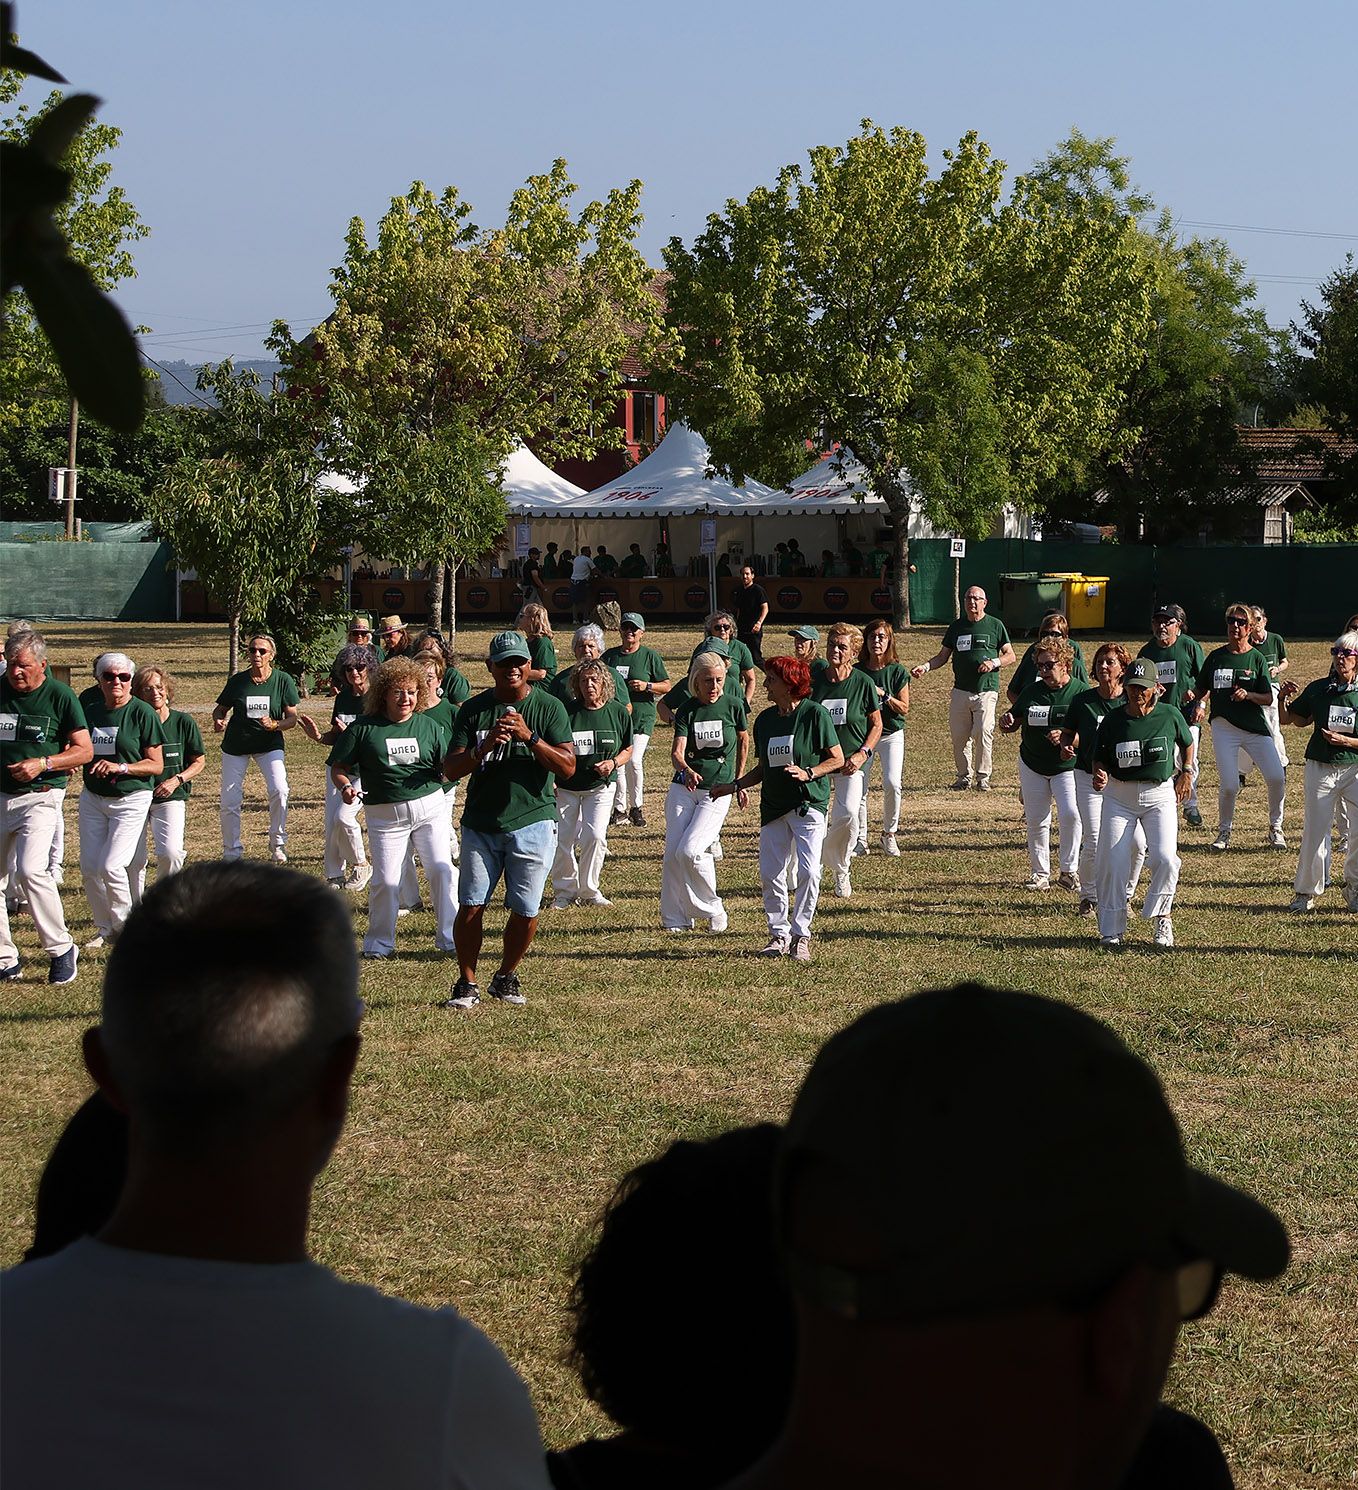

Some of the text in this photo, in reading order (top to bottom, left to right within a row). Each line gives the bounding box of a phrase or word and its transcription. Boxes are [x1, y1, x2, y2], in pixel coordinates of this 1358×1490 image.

[602, 490, 659, 501] 1906
[790, 489, 848, 500] 1906
[248, 703, 267, 711] UNED
[830, 707, 843, 715] NED
[1331, 715, 1352, 725] UNED
[0, 722, 14, 731] NED
[697, 731, 720, 740] UNED
[93, 736, 113, 745] UNED
[573, 737, 592, 747] UNED
[391, 745, 416, 756] UNED
[769, 745, 790, 755] UNED
[1116, 750, 1138, 759] UNED
